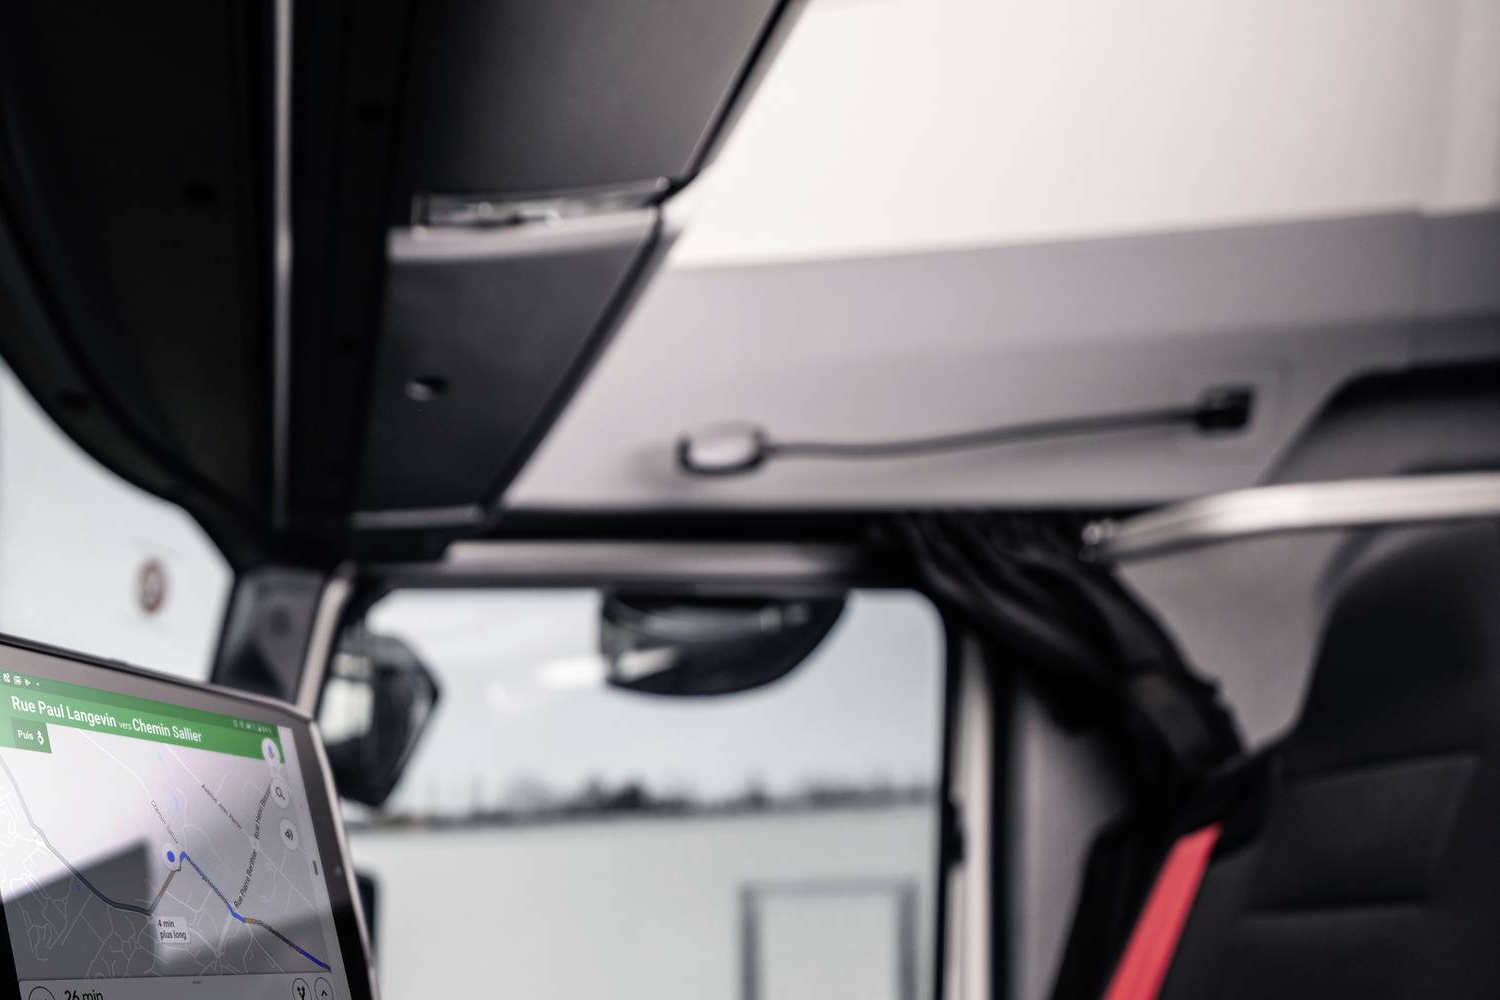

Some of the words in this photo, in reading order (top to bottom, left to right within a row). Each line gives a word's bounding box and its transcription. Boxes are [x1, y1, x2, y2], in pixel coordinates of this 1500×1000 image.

[11, 695, 36, 713] Rue
[37, 700, 64, 718] Paul
[66, 705, 117, 727] Langevin
[132, 718, 171, 737] Chemin
[172, 725, 202, 742] Sallier
[17, 729, 34, 740] Puis
[163, 920, 175, 928] min
[160, 930, 173, 941] plus
[173, 930, 187, 941] long
